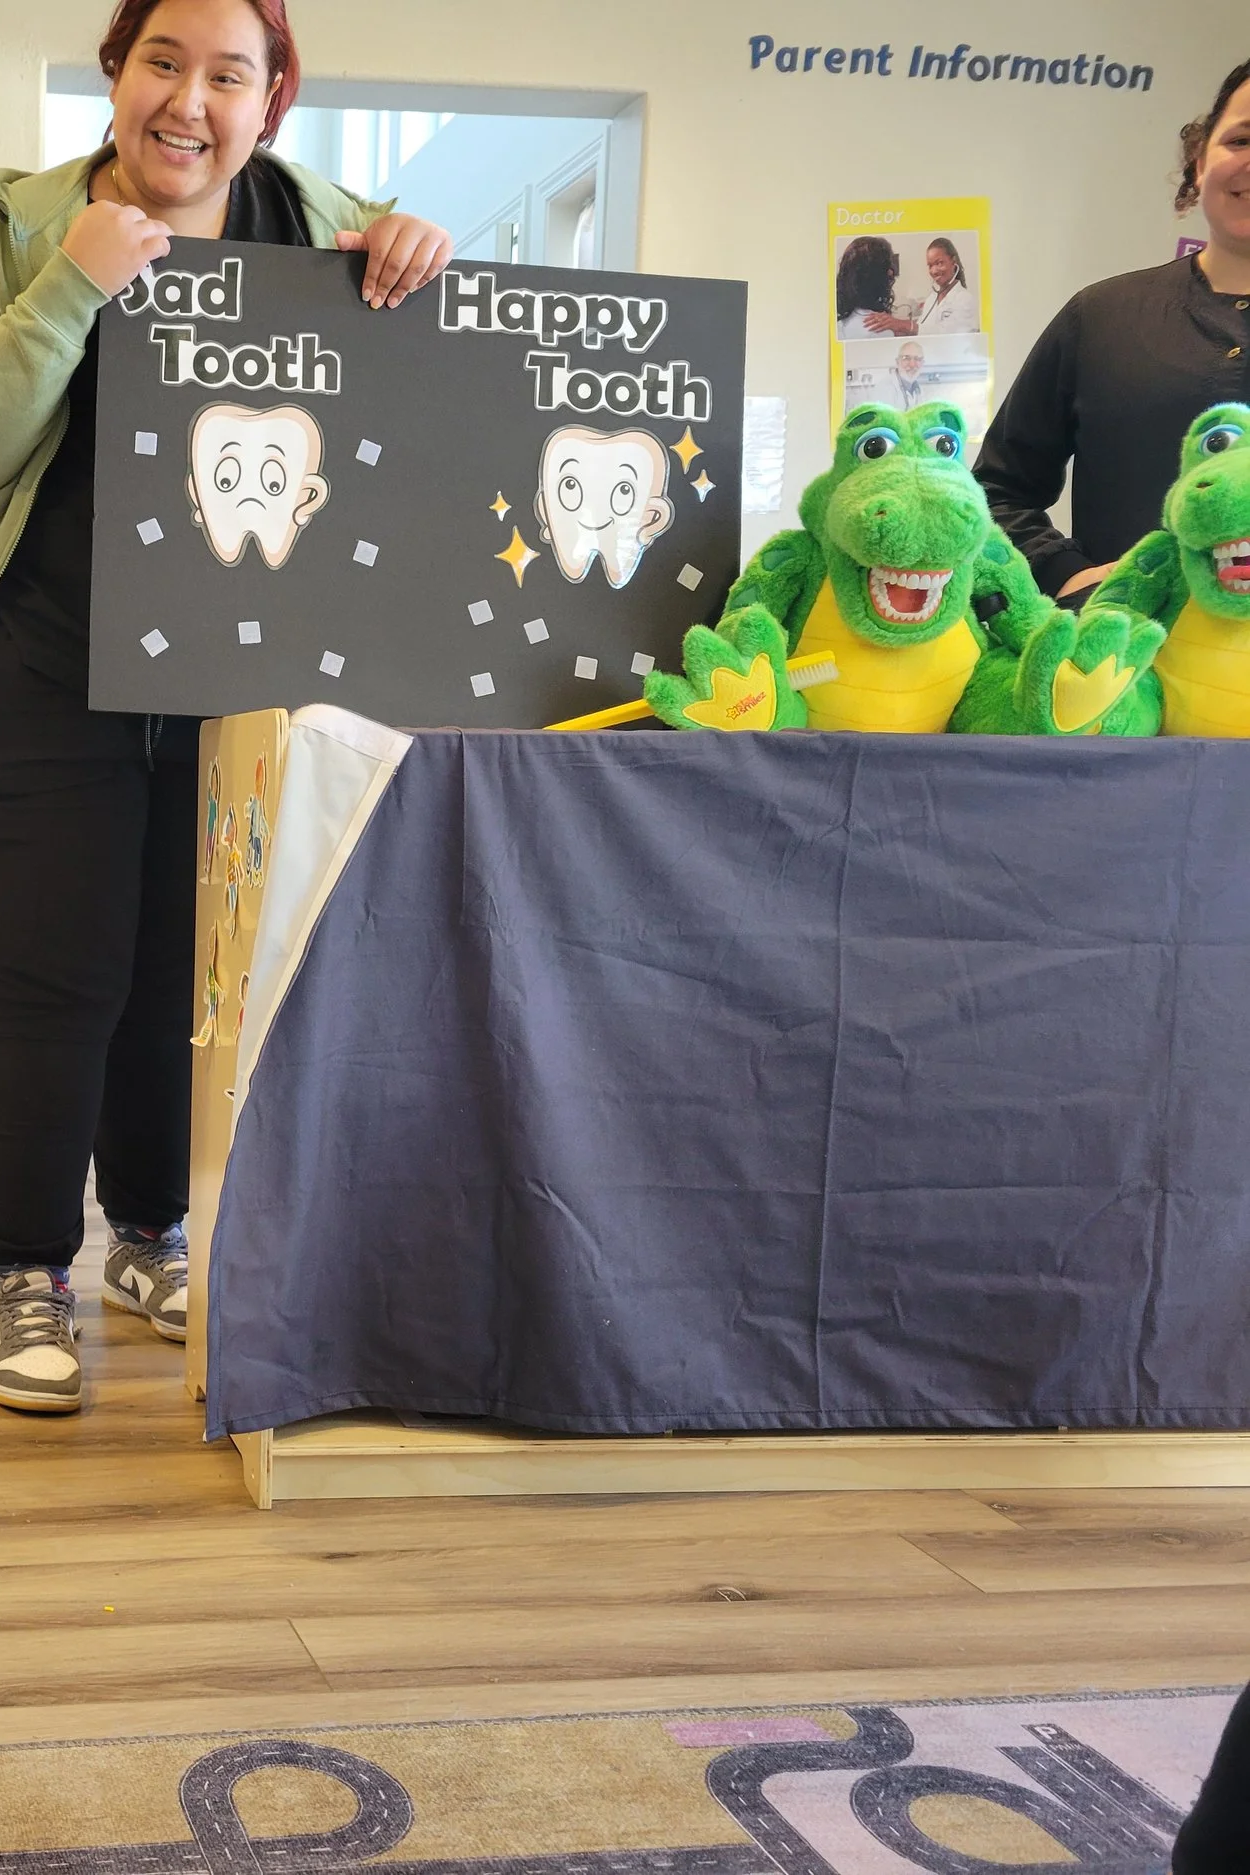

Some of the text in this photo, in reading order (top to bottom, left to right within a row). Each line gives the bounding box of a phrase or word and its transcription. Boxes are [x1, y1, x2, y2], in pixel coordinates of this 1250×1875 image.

[748, 34, 1154, 91] Parent Information
[835, 207, 905, 226] Doctor
[439, 270, 668, 353] Happy
[149, 324, 341, 394] Tooth
[525, 350, 711, 421] Tooth
[1034, 1726, 1057, 1740] P
